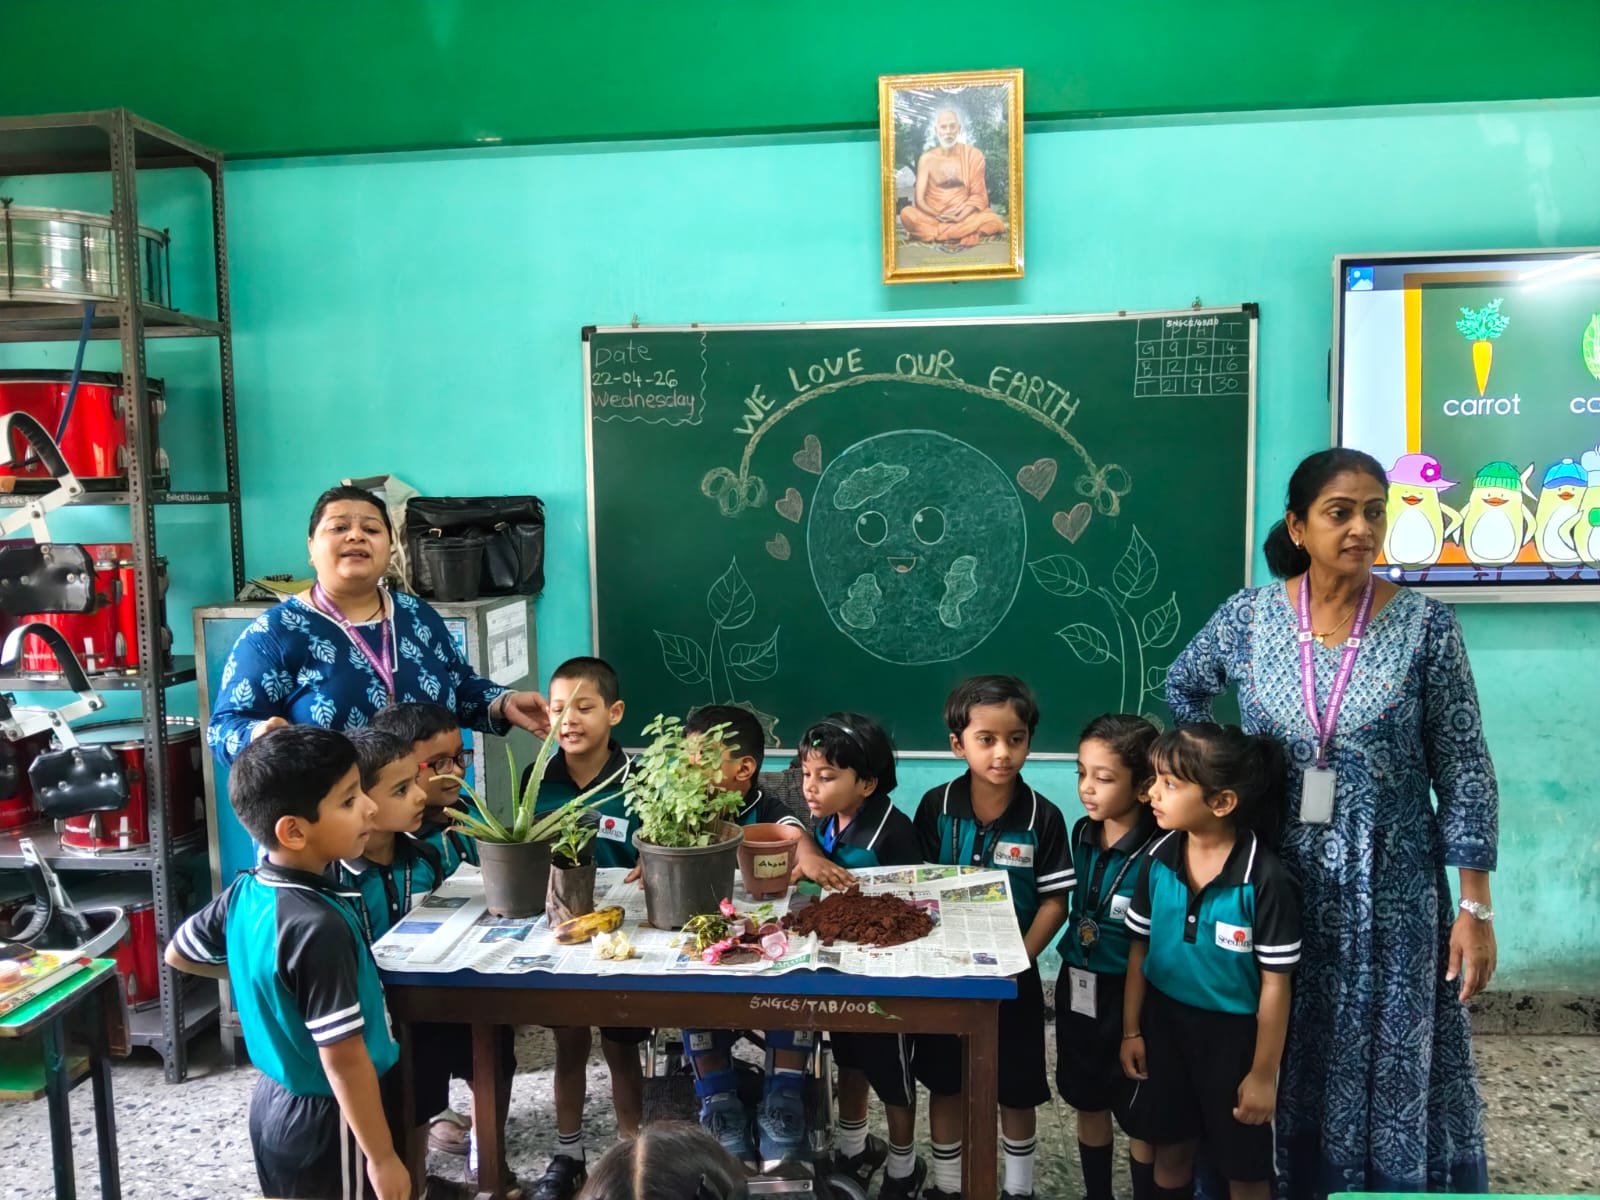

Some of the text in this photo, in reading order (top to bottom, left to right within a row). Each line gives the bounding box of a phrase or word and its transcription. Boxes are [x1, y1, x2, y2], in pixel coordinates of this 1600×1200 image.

[1222, 321, 1244, 336] T
[595, 339, 652, 368] Date
[1141, 342, 1155, 357] G
[1196, 341, 1208, 355] 5
[1221, 342, 1237, 356] 14
[1141, 358, 1239, 378] B 12 4 16
[591, 369, 678, 388] 22-04-26
[1162, 378, 1177, 393] 21
[1215, 377, 1239, 392] 30
[733, 348, 1081, 434] WE LOVE OUR EARTH
[590, 390, 696, 417] Wednesday
[1442, 393, 1521, 416] carrot
